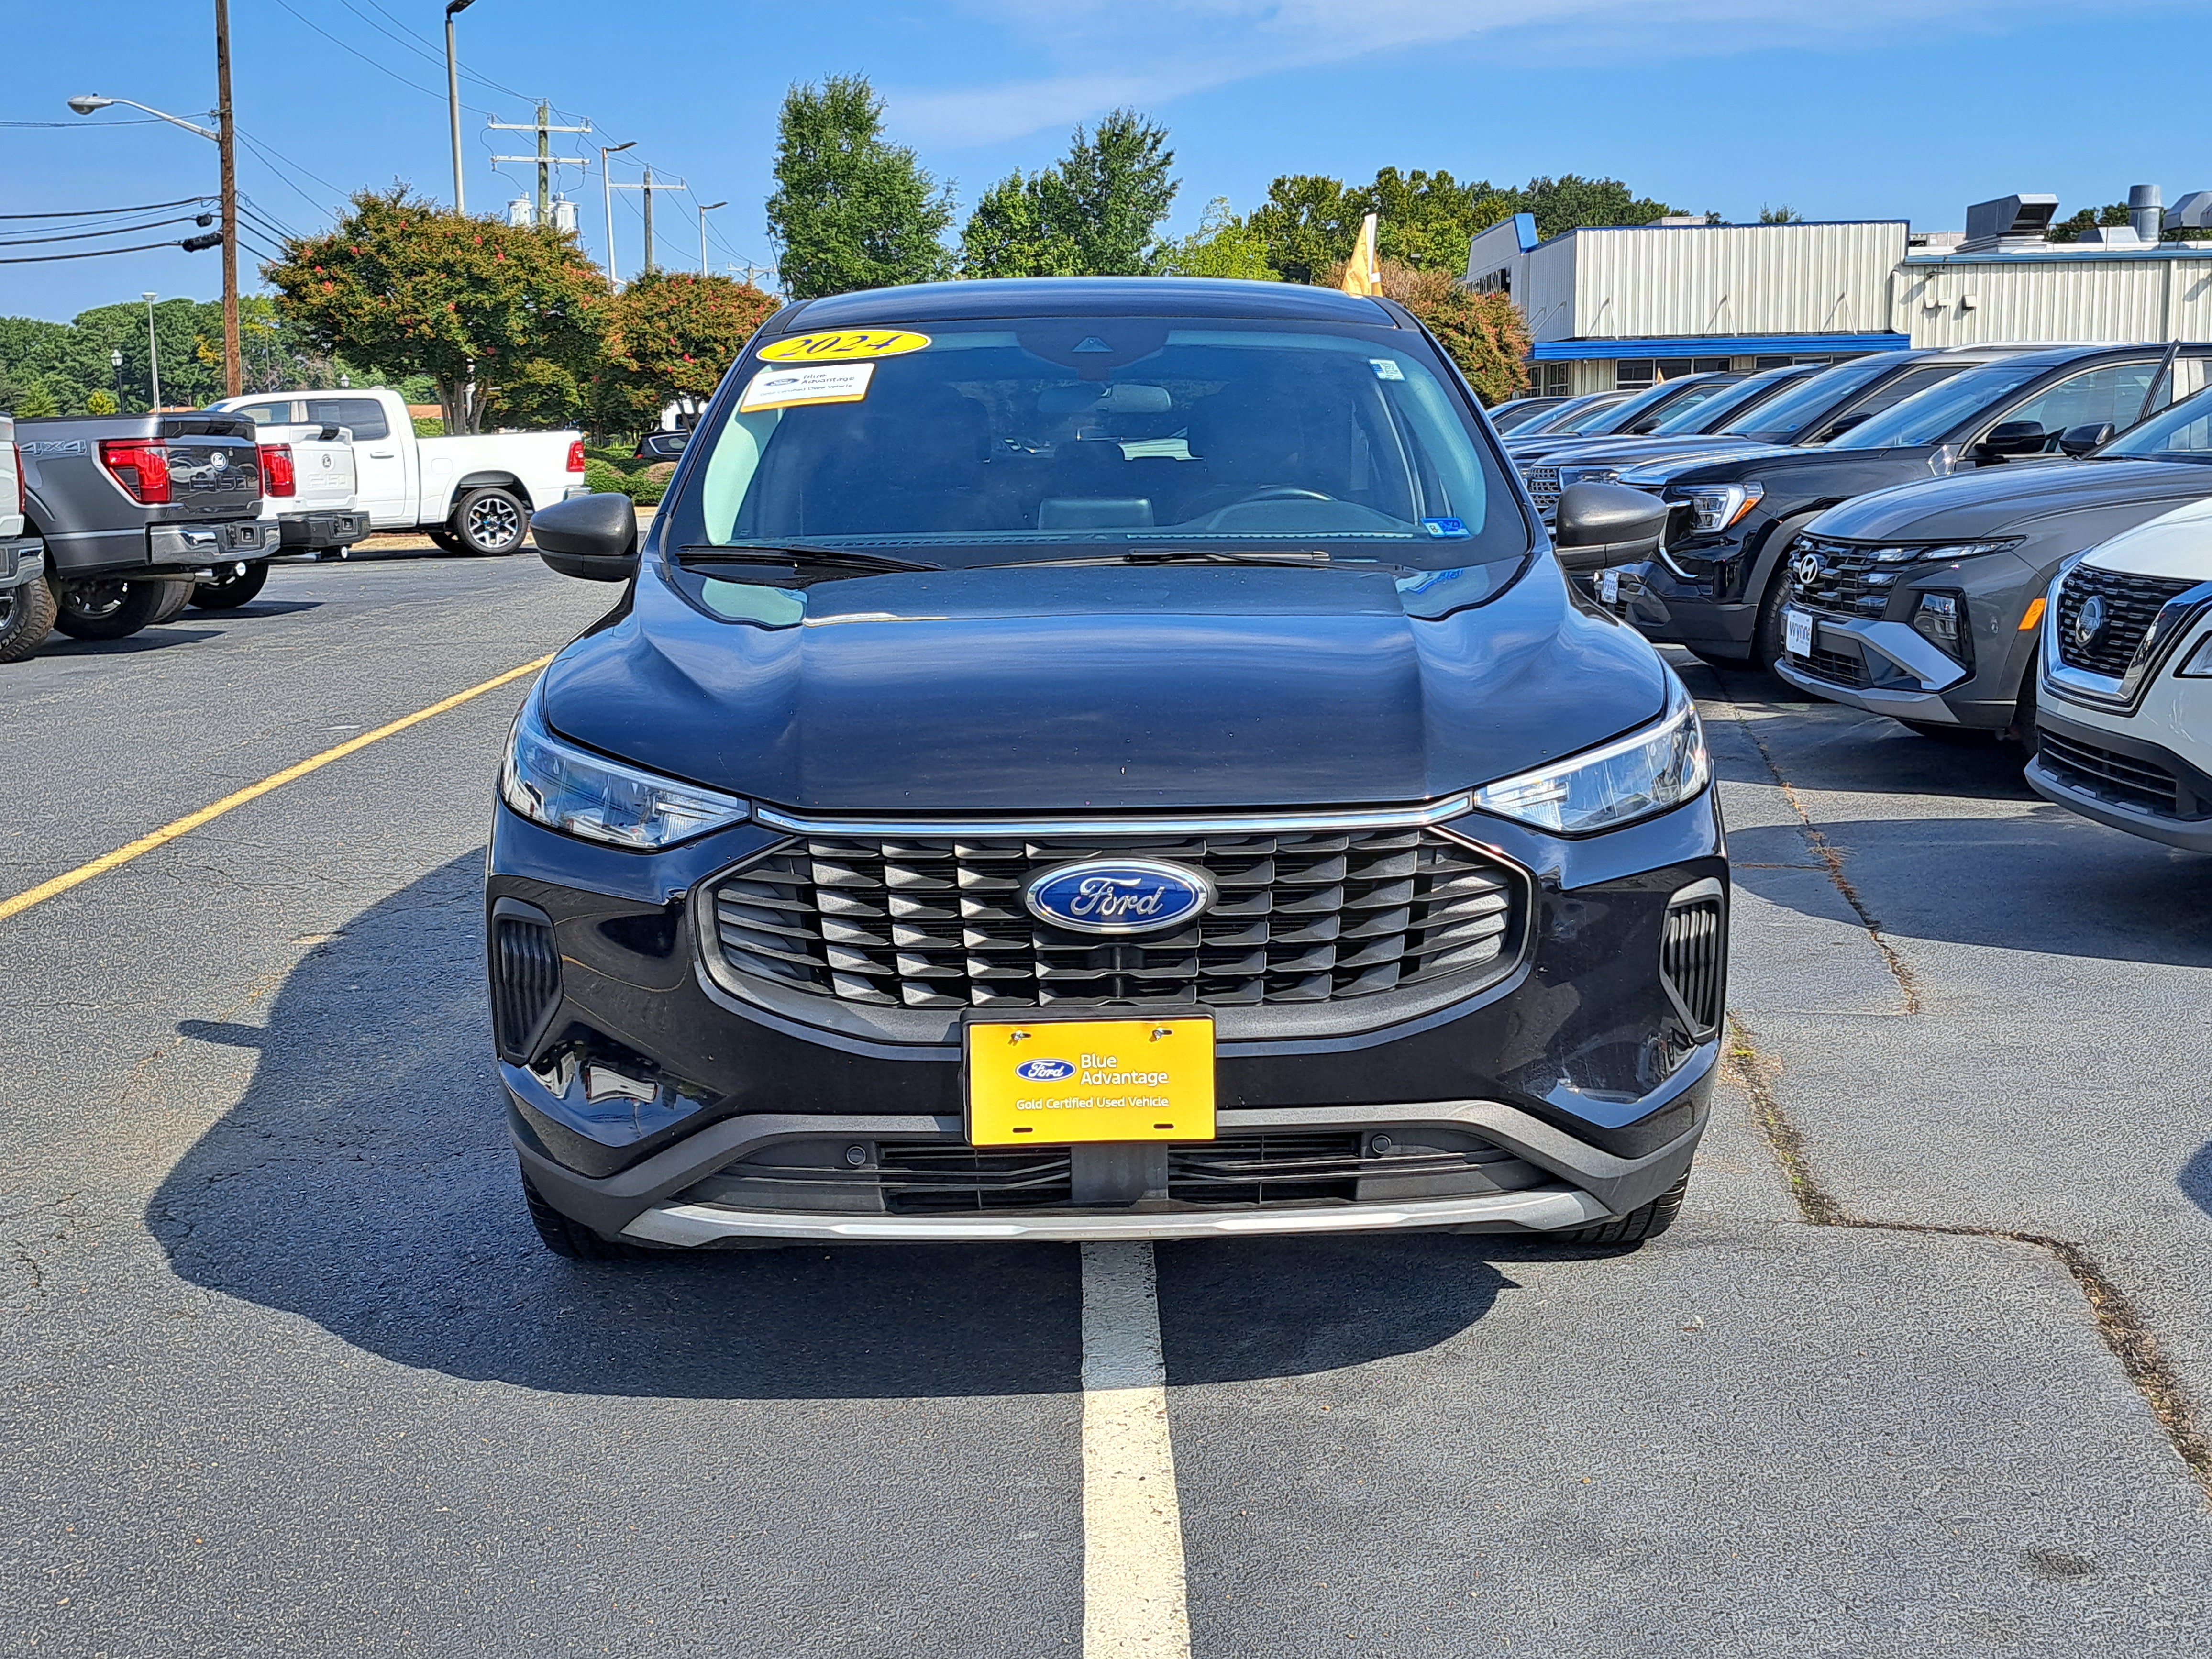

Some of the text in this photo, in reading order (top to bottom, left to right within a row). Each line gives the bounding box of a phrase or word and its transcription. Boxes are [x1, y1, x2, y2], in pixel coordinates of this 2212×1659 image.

[774, 334, 904, 358] 2024
[1070, 876, 1165, 916] Ford
[1080, 1053, 1117, 1068] Blue
[1027, 1062, 1064, 1077] Ford
[1080, 1070, 1169, 1086] Advantage
[1016, 1095, 1170, 1110] Gold Certified Used Vehicle
